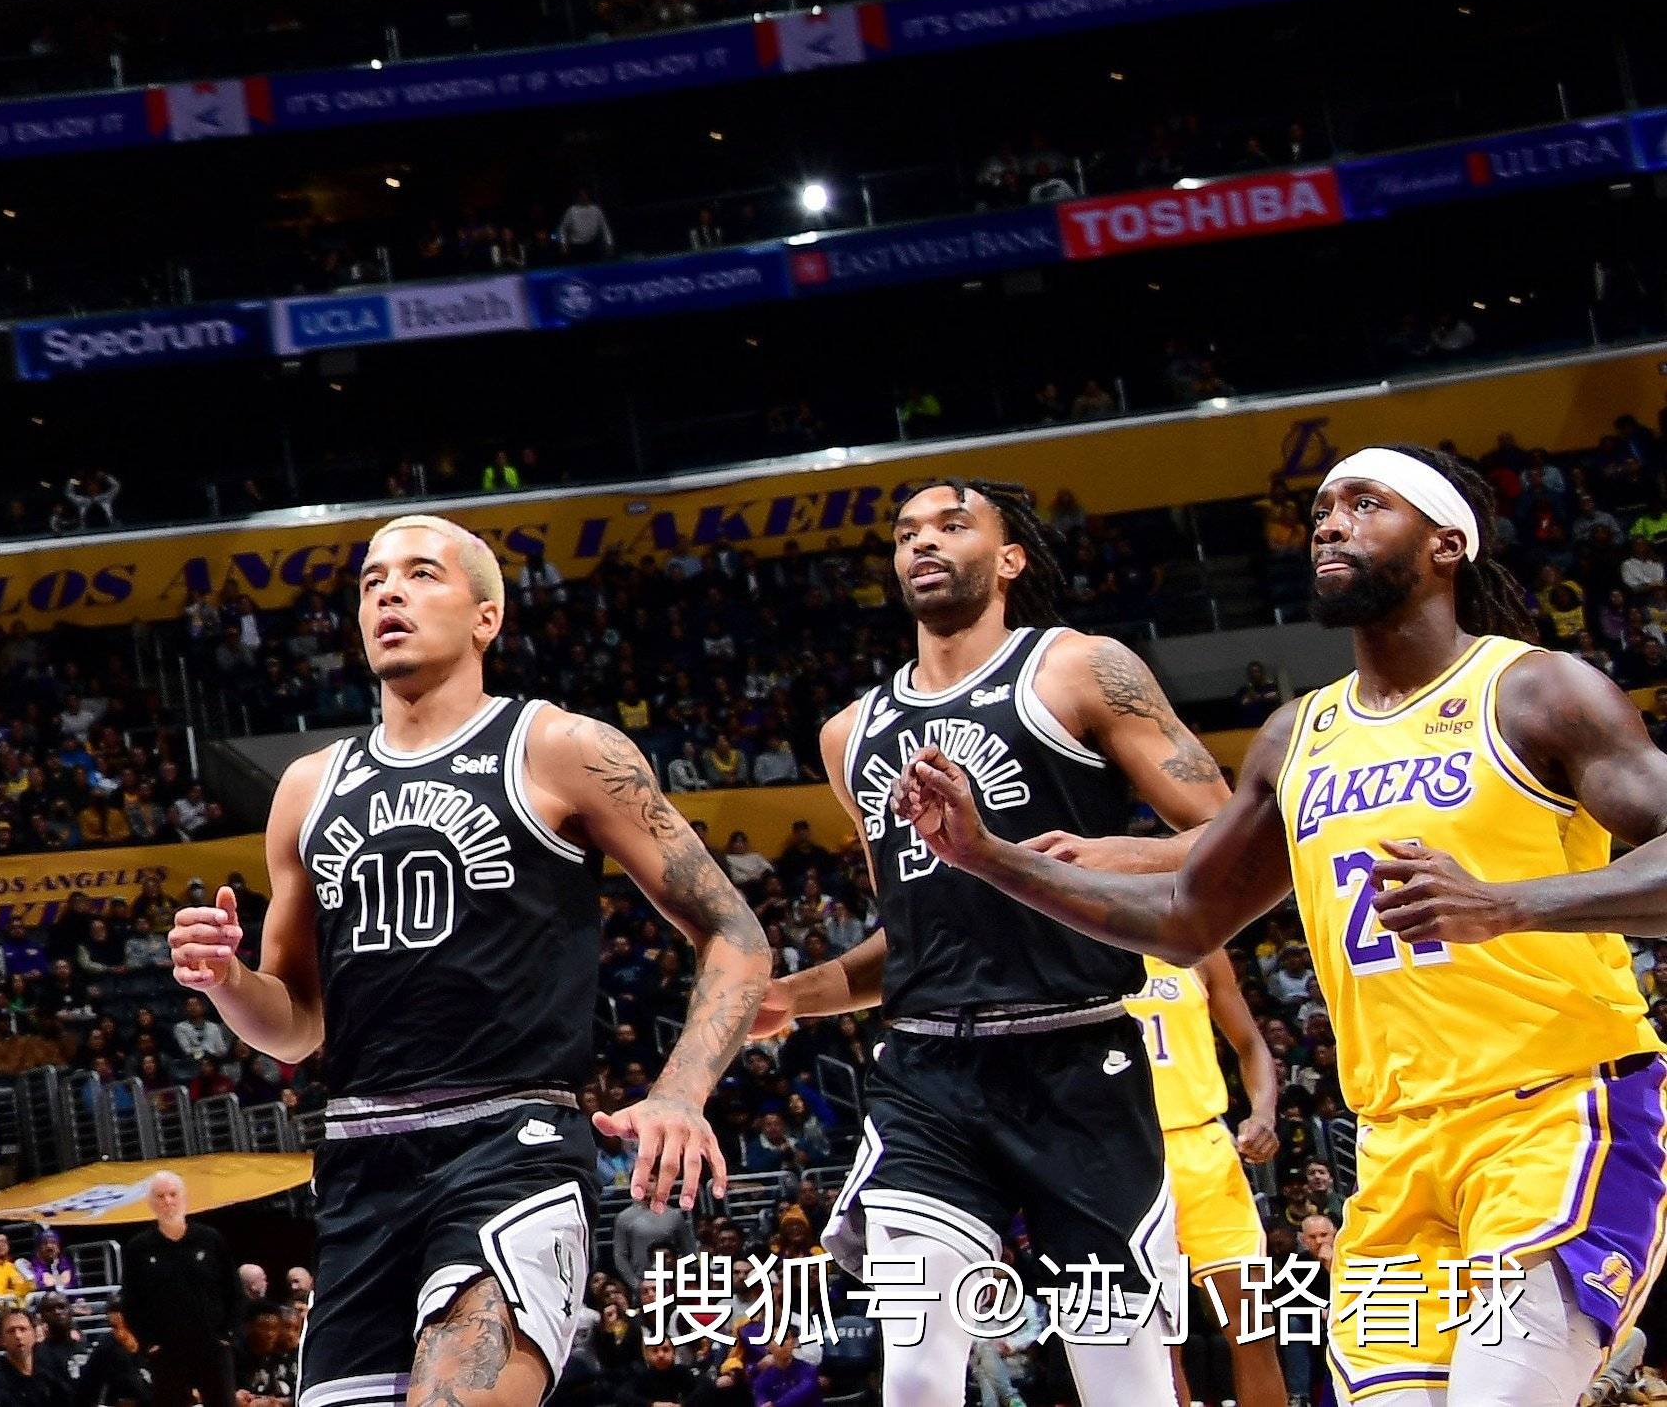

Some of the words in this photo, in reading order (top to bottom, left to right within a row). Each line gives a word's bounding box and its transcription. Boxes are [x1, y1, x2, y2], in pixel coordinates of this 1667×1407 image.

[1487, 137, 1620, 179] ULTRA
[1068, 181, 1328, 248] TOSHIBA
[297, 307, 381, 337] UCLA
[396, 293, 517, 330] Health
[43, 319, 237, 370] Spectrum
[1424, 720, 1474, 735] bibigo
[1295, 751, 1475, 844] LAKERS
[311, 815, 365, 910] SAN
[368, 780, 515, 891] ANTONIO
[32, 864, 169, 892] ANGELES
[350, 849, 455, 953] 10
